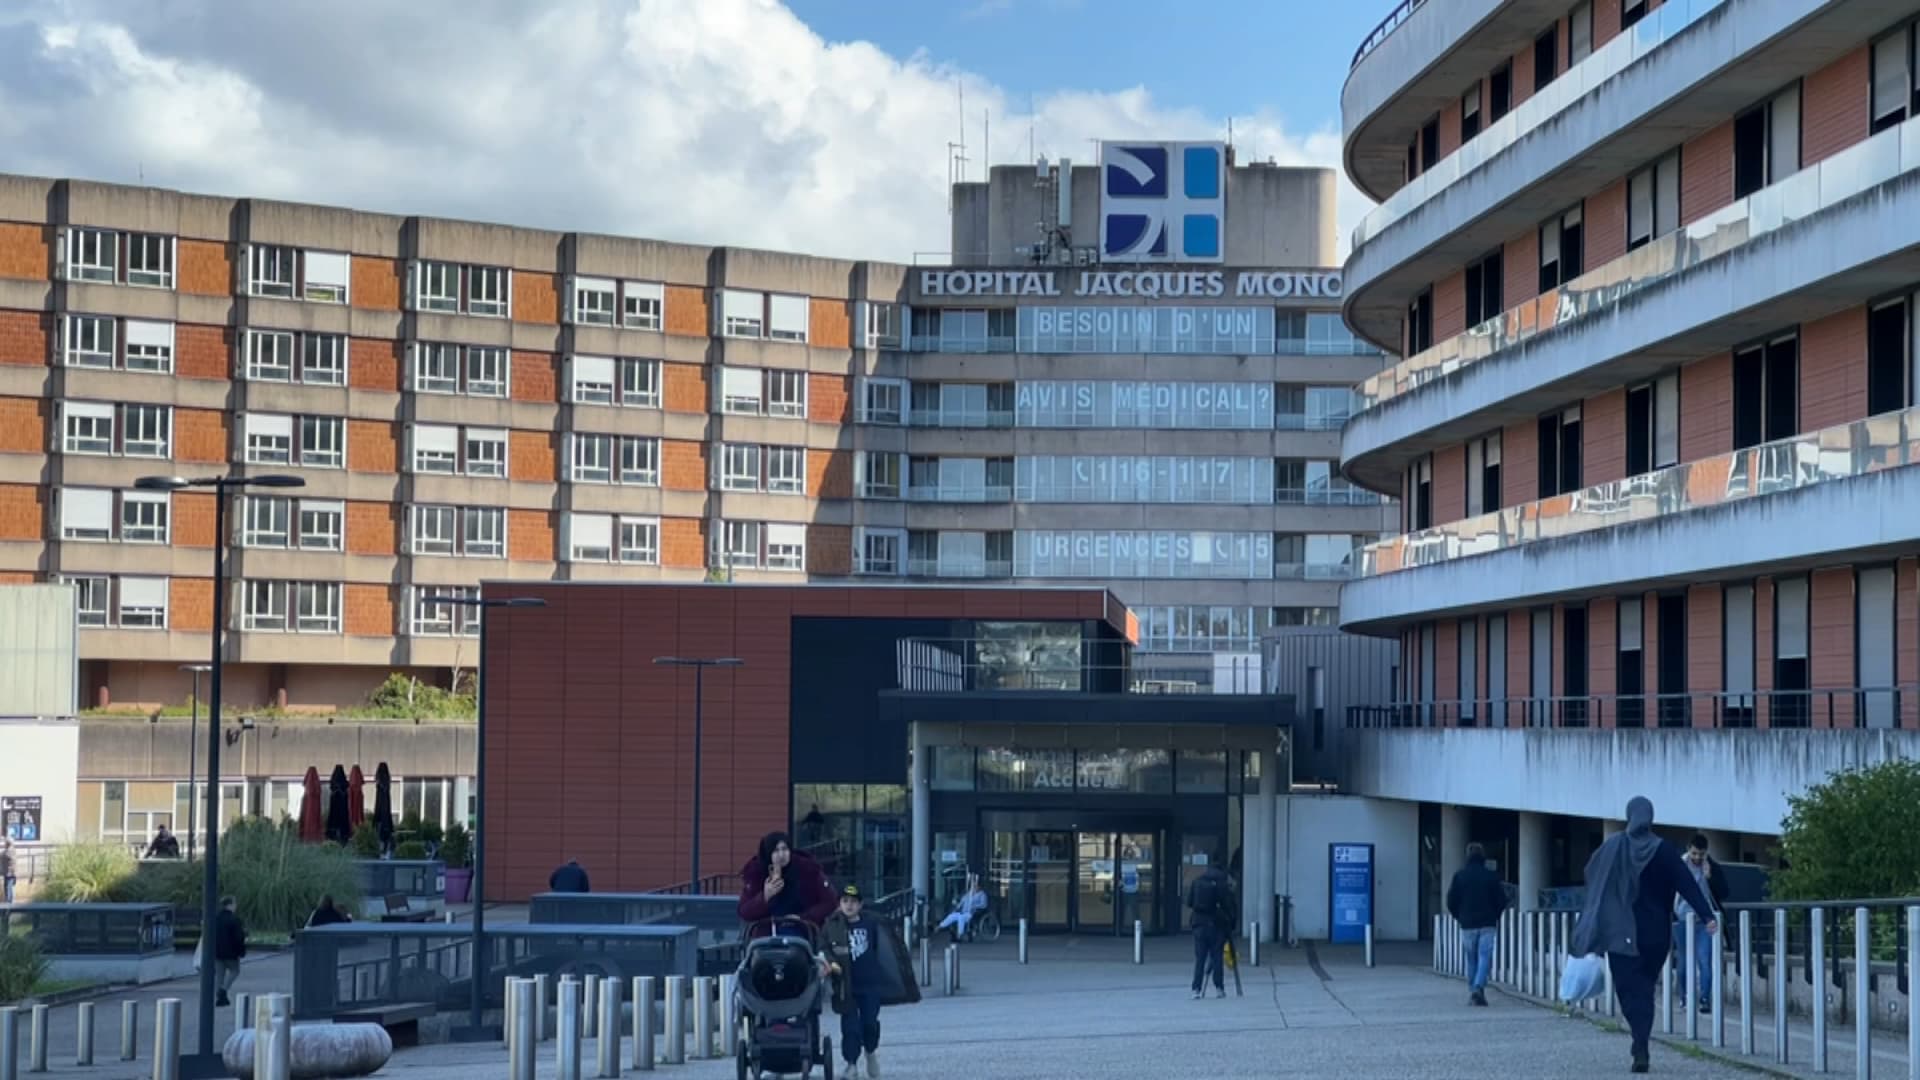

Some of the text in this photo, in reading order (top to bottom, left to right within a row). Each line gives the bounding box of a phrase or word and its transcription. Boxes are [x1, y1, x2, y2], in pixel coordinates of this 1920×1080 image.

[1074, 271, 1224, 299] JACQUES
[1039, 312, 1250, 334] BESOIN D'UN
[1019, 387, 1091, 408] AVIS
[1098, 462, 1230, 484] 116-117
[1036, 536, 1268, 558] URGENCES 15
